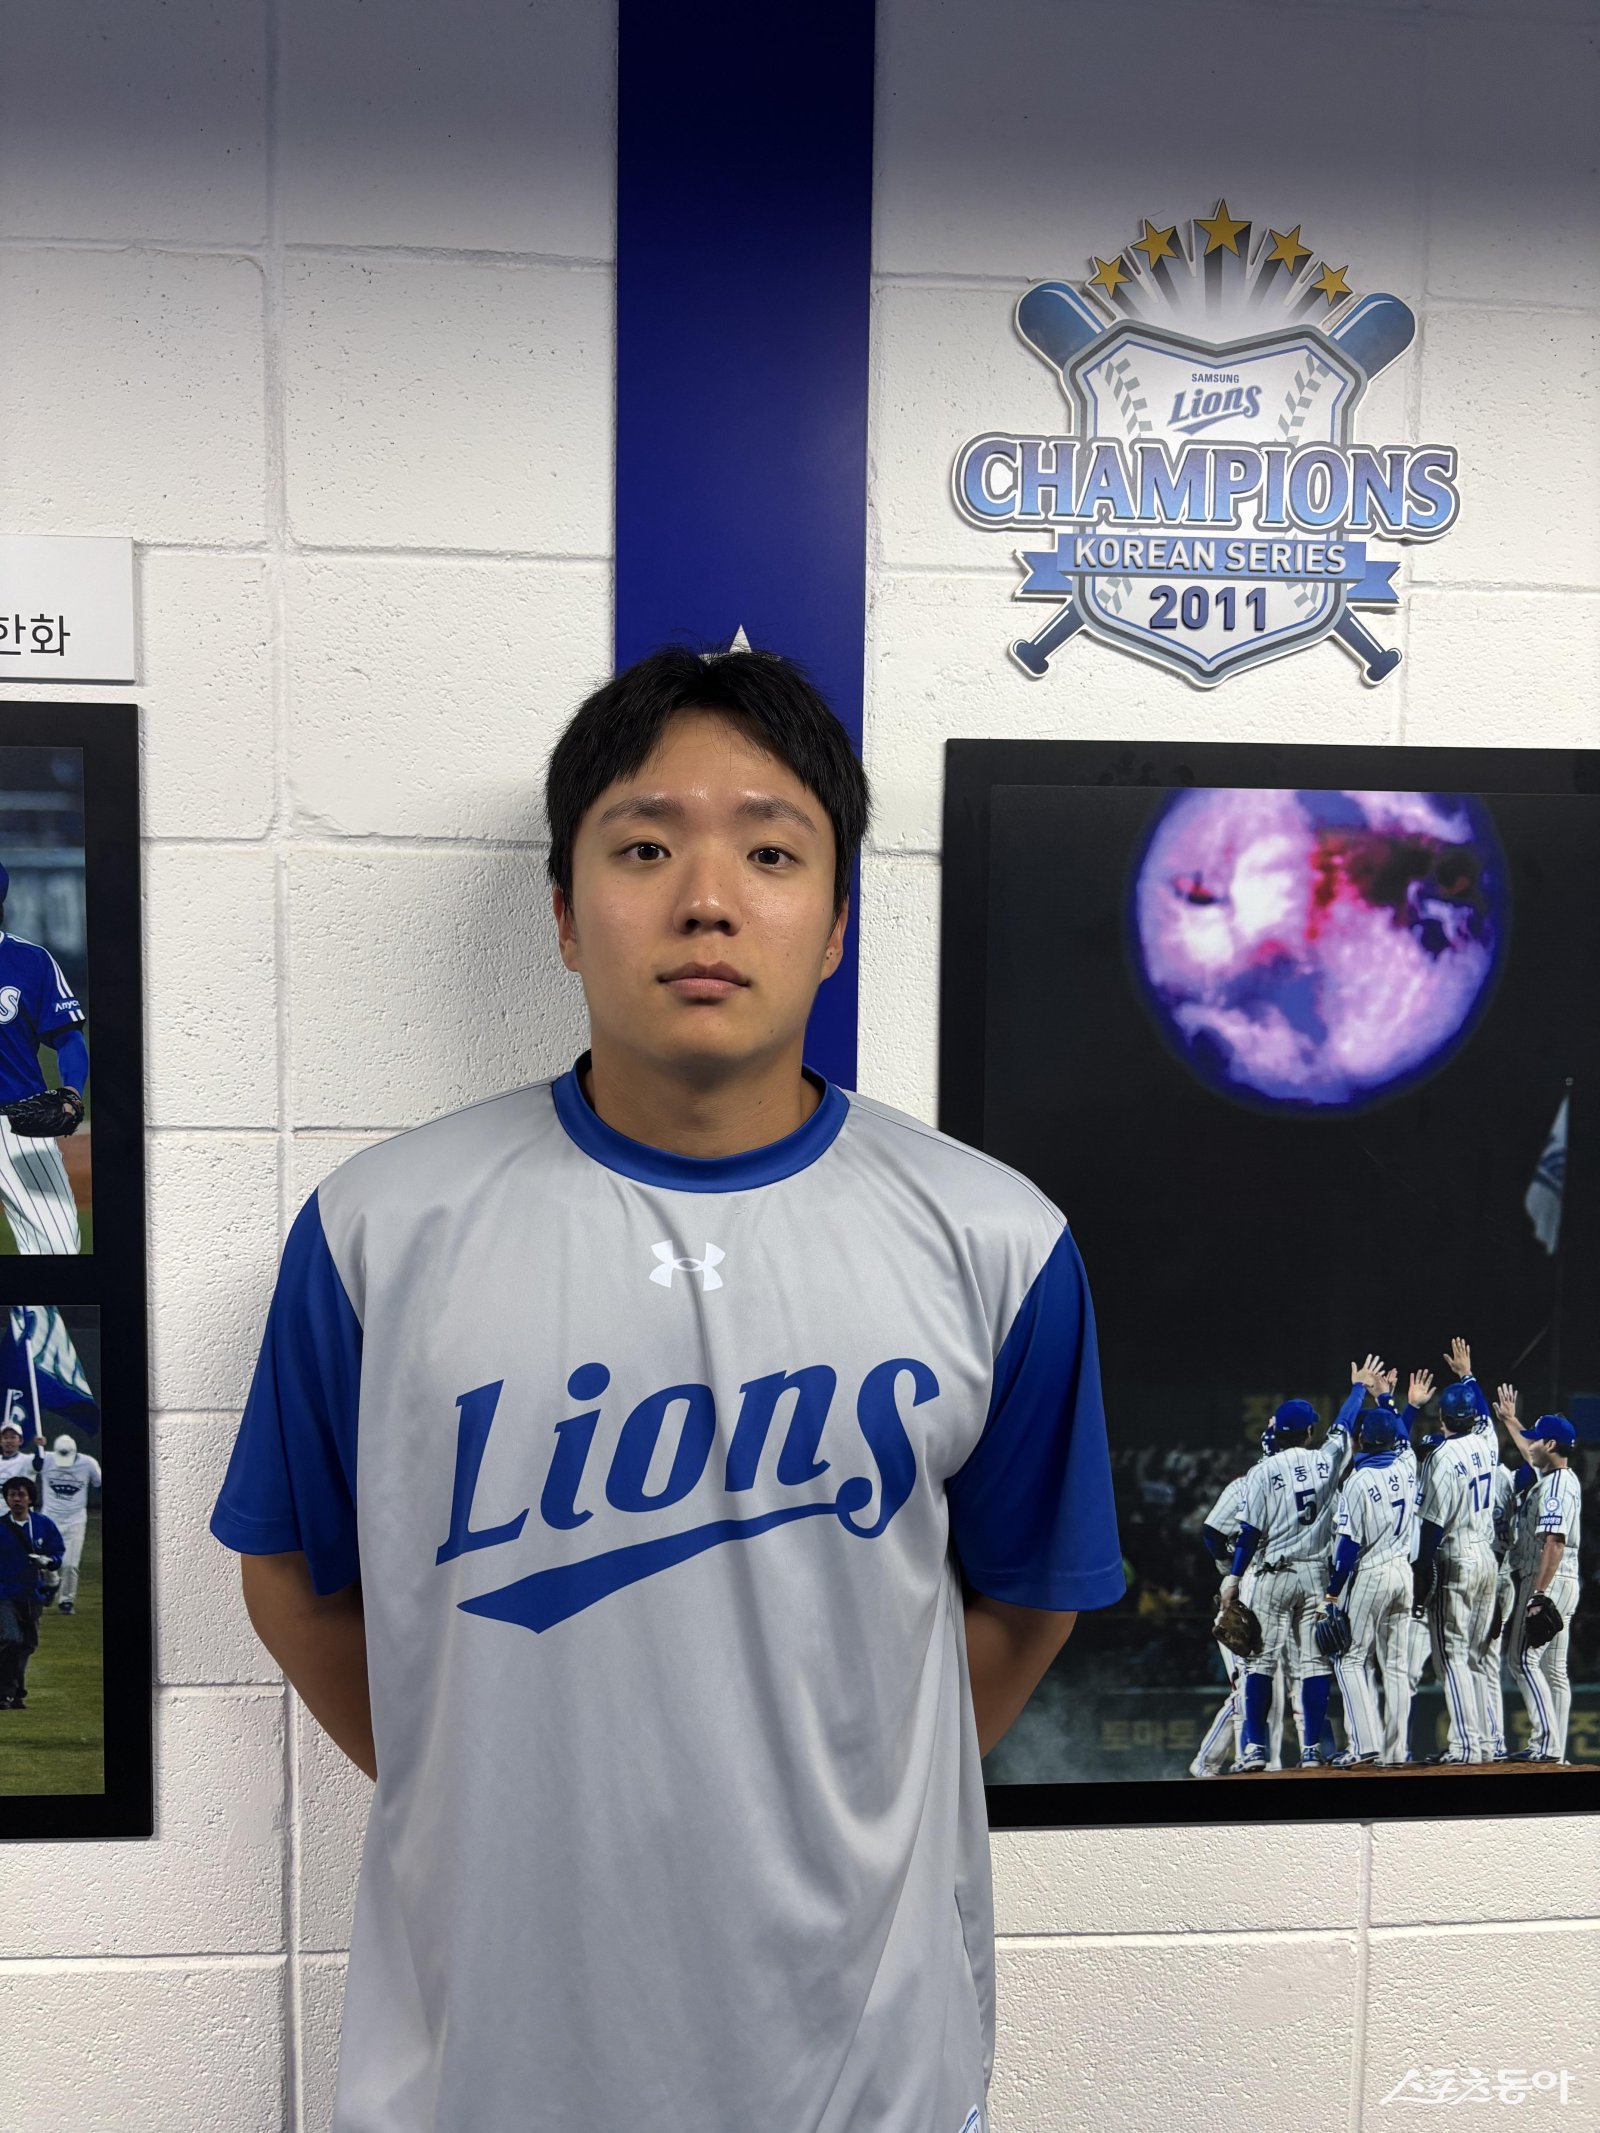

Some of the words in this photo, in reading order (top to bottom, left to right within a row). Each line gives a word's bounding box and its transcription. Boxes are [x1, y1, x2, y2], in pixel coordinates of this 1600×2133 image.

[1191, 373, 1240, 384] SAMSUNG
[1166, 385, 1263, 428] Lions
[959, 438, 1455, 532] CHAMPIONS
[1073, 537, 1217, 572] KOREAN
[1225, 541, 1347, 574] SERIES
[1148, 584, 1268, 633] 2011
[435, 1357, 940, 1567] Lions
[1295, 1488, 1317, 1526] 5
[1468, 1471, 1492, 1513] 17
[1391, 1498, 1406, 1537] 7
